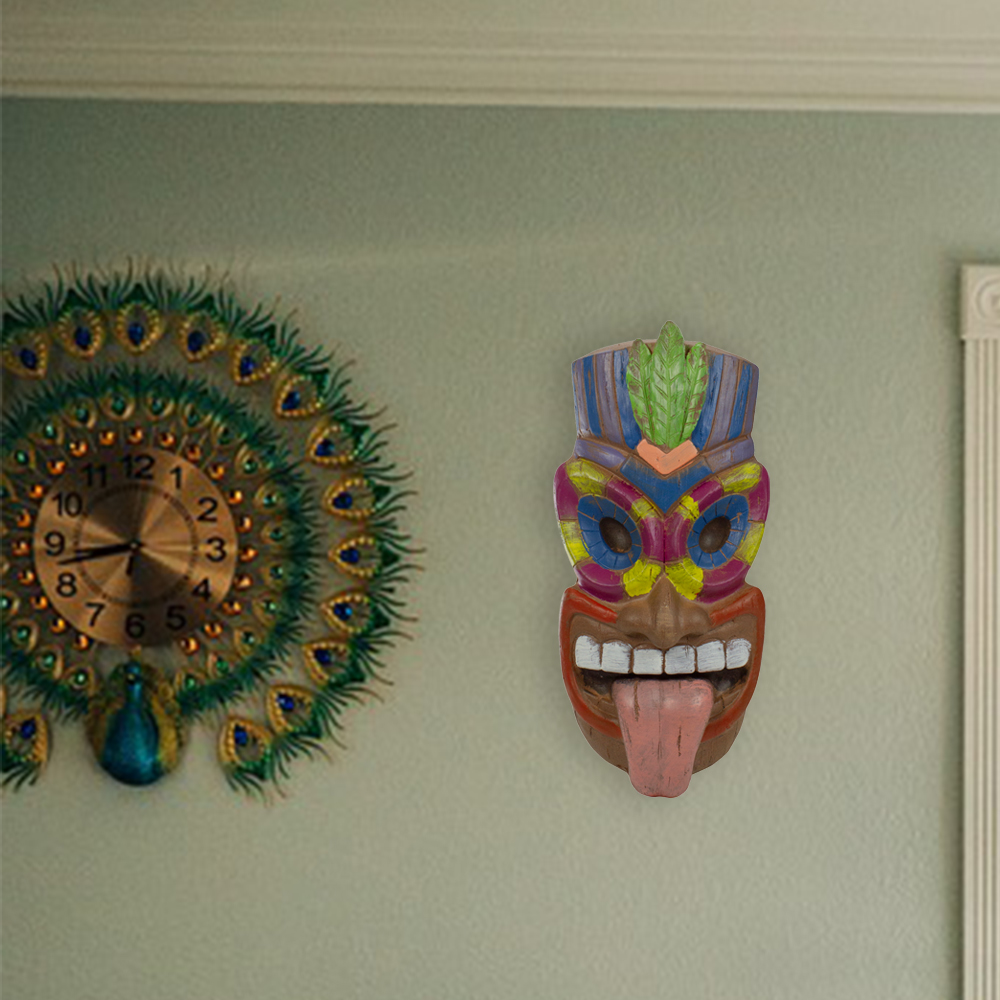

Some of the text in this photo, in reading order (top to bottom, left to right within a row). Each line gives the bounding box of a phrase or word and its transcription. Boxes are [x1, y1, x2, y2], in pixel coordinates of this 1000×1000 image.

[83, 464, 108, 488] 11
[124, 454, 155, 480] 12
[170, 466, 183, 490] 1
[52, 492, 83, 517] 10
[196, 496, 218, 523] 2
[44, 531, 66, 557] 9
[205, 536, 227, 563] 3
[55, 572, 78, 598] 8
[192, 577, 212, 601] 4
[85, 602, 106, 627] 7
[124, 613, 146, 639] 6
[166, 605, 187, 631] 5
